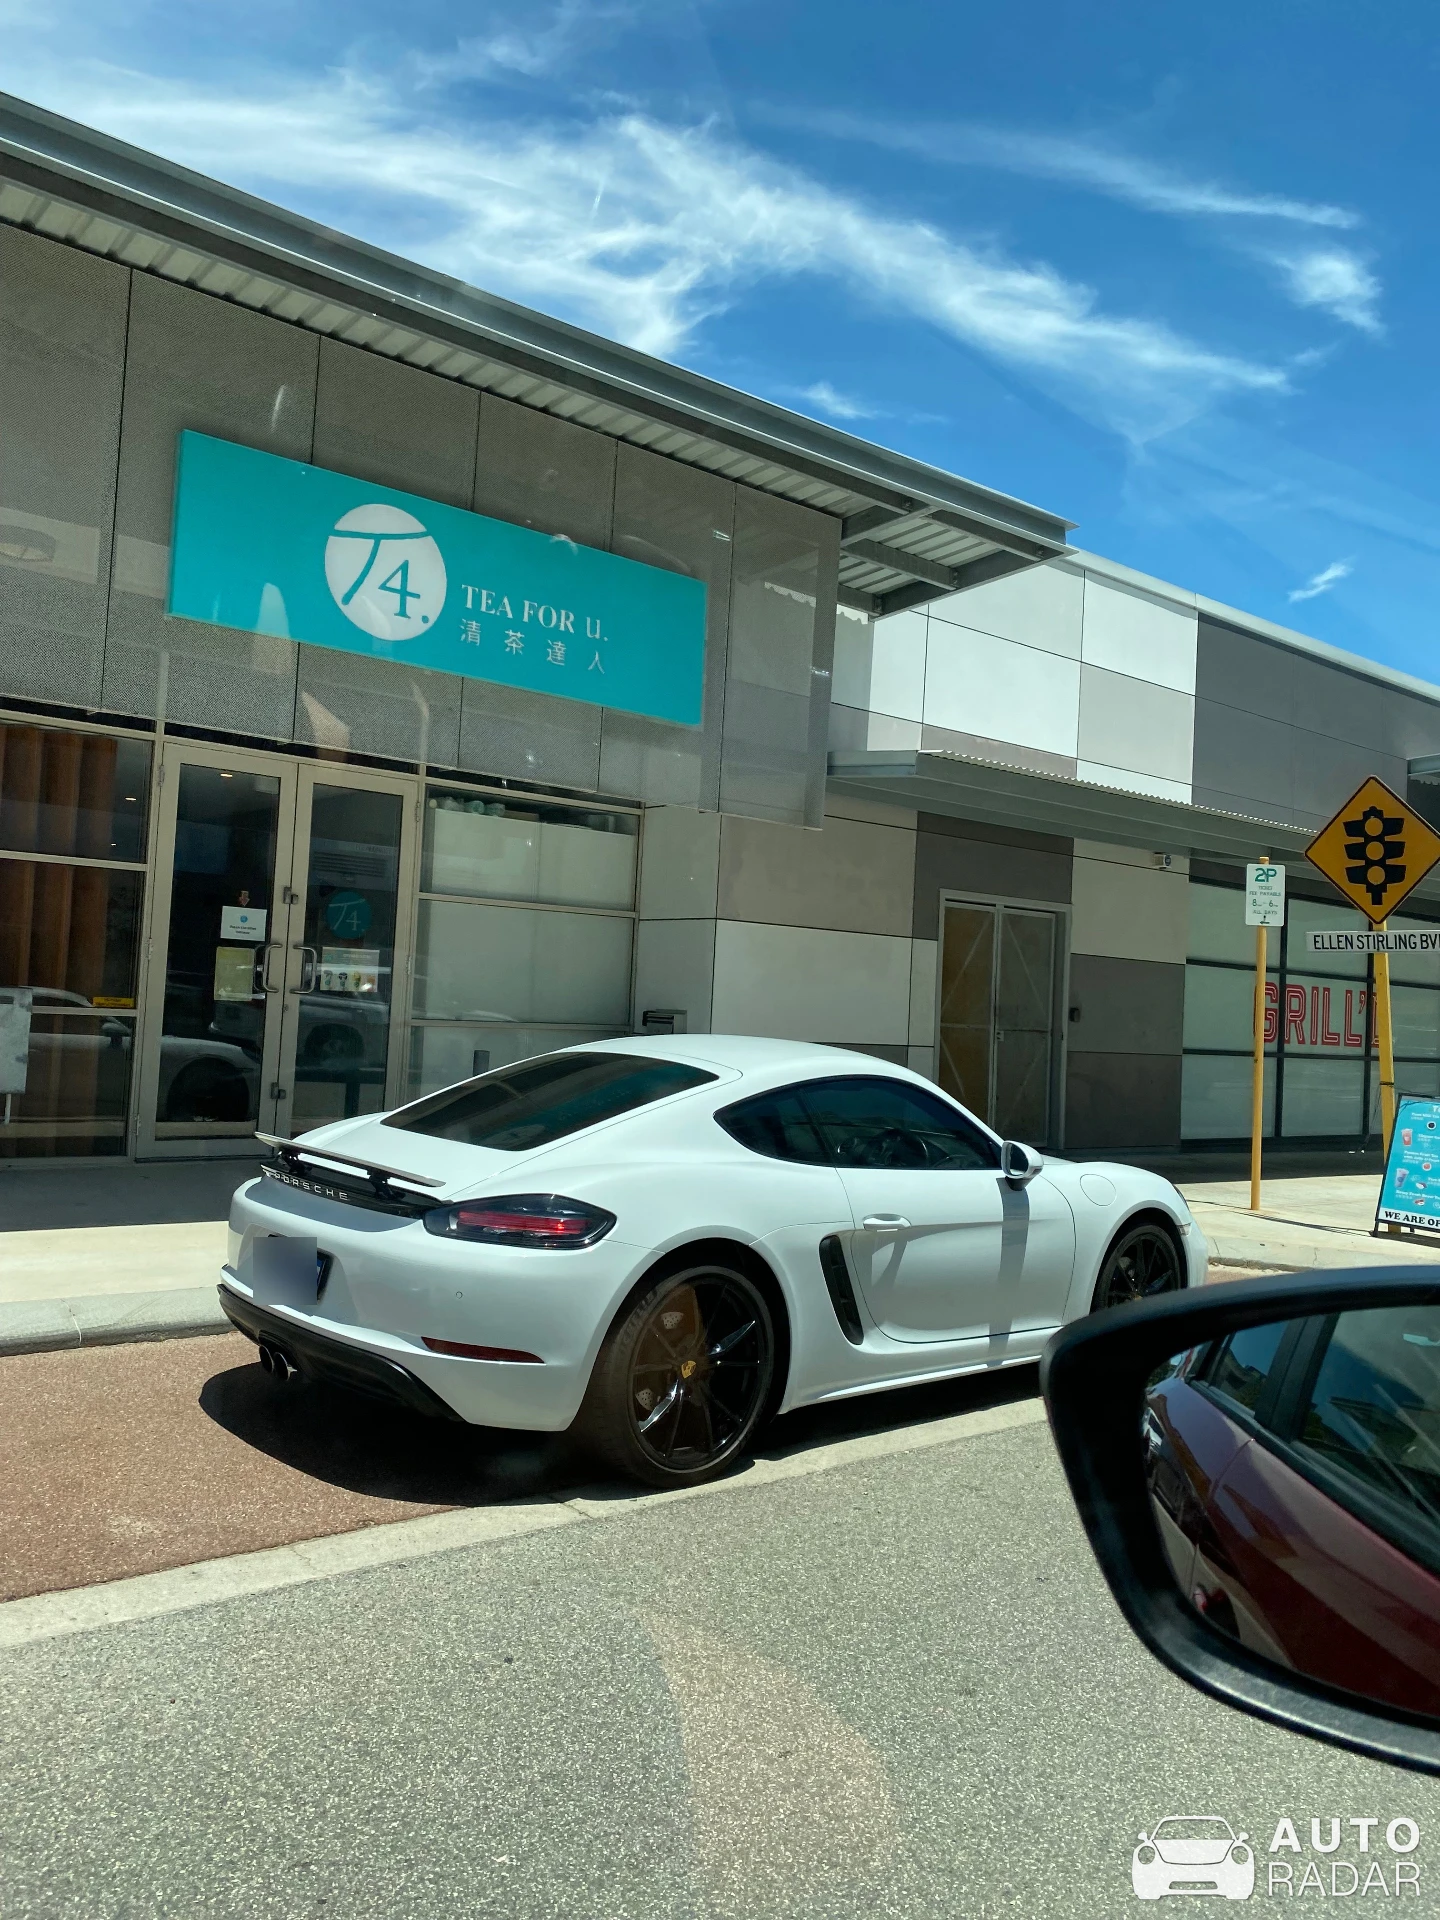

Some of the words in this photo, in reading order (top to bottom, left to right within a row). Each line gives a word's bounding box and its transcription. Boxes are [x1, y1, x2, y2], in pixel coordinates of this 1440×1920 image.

[461, 584, 514, 619] TEA
[522, 599, 575, 634] FOR
[1254, 867, 1277, 882] 2P
[1313, 934, 1354, 950] ELLEN
[1356, 933, 1417, 950] STIRLING
[1419, 933, 1440, 950] BV
[272, 1171, 348, 1201] PORSCHE
[1384, 1211, 1401, 1221] WE
[1402, 1214, 1426, 1225] ARE
